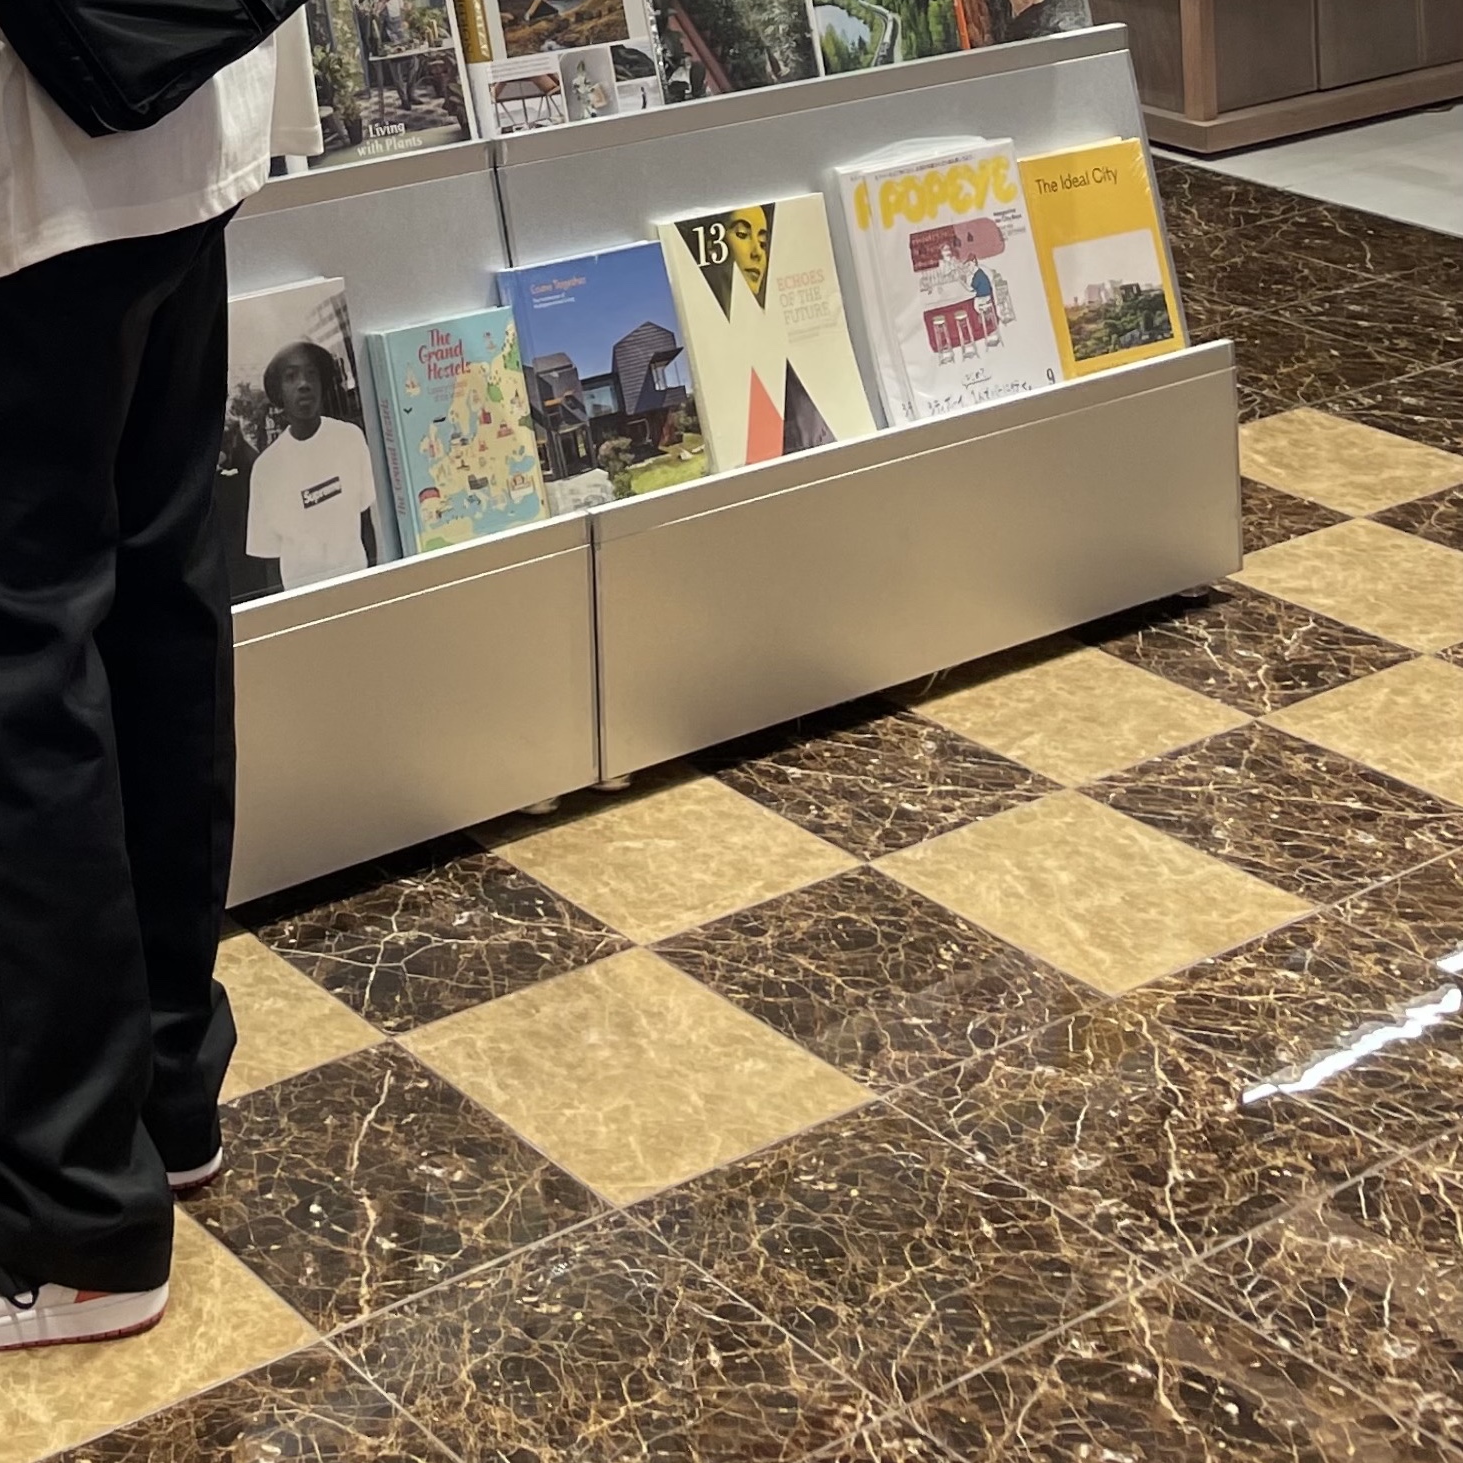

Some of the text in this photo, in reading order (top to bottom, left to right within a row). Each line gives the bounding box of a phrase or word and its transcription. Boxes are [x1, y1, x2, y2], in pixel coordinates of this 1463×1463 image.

[368, 121, 406, 139] Living
[357, 136, 423, 157] with Plants
[878, 155, 1018, 230] POPEYE
[1035, 166, 1118, 195] The Ideal City
[692, 222, 729, 268] 13
[776, 268, 825, 292] ECHOES
[779, 286, 822, 308] OF THE
[783, 301, 831, 325] FUTURE
[427, 328, 450, 347] The
[418, 338, 464, 364] Grand
[427, 356, 471, 381] Hostels
